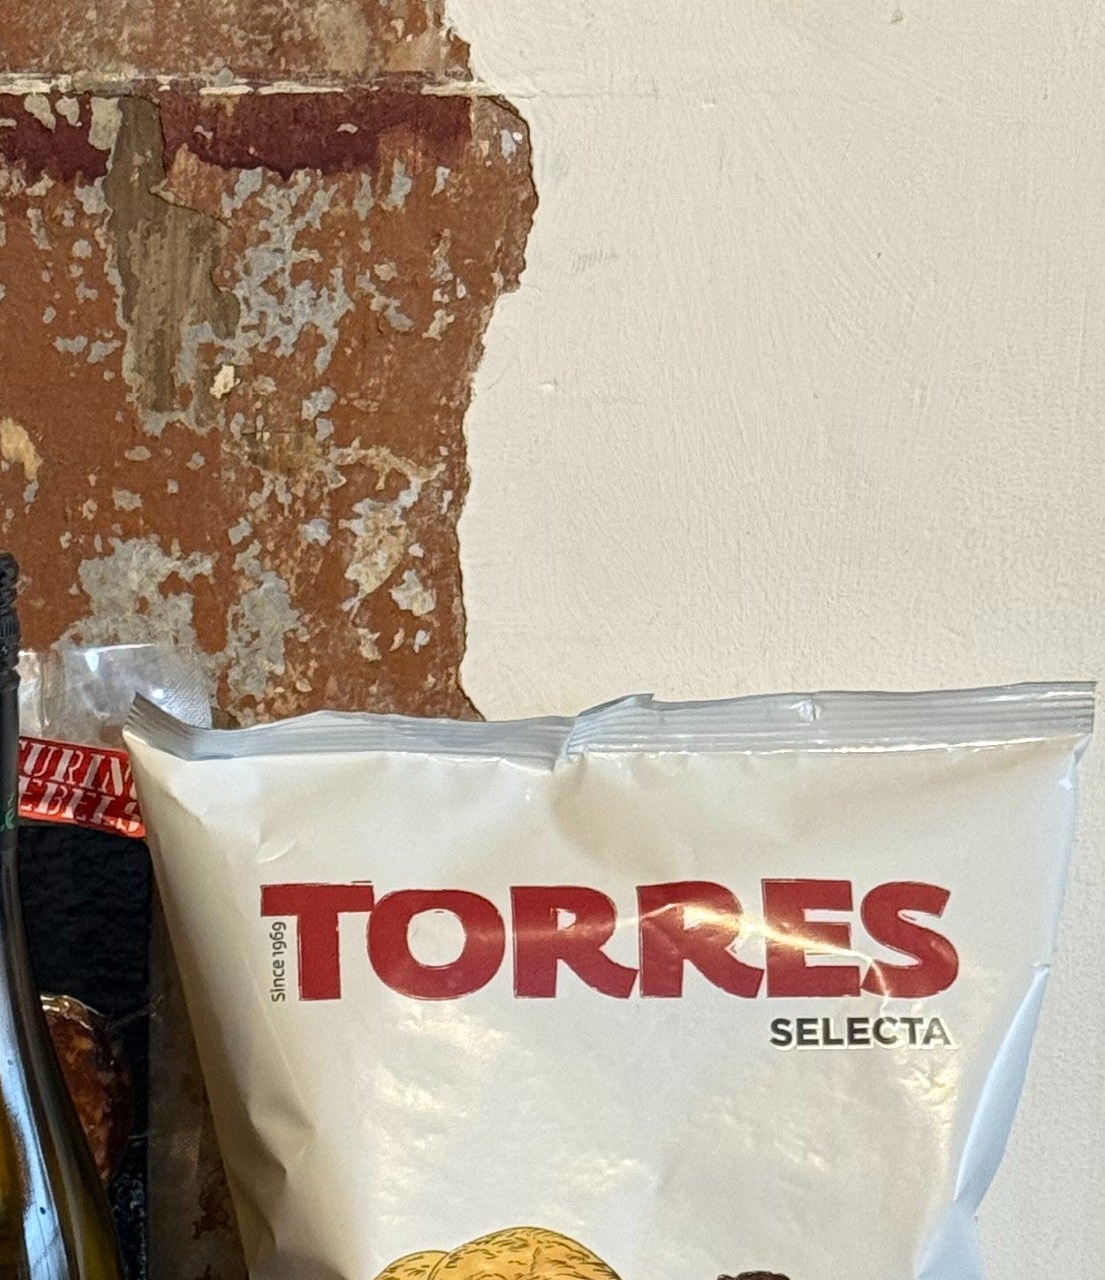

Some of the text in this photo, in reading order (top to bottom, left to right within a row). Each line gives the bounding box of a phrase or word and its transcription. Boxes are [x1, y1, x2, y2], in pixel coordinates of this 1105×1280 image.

[19, 740, 137, 800] URIN
[19, 775, 142, 832] EBELS
[260, 879, 960, 1000] TORRES
[269, 921, 287, 1002] Since 1969
[769, 1016, 952, 1046] SELECTA
